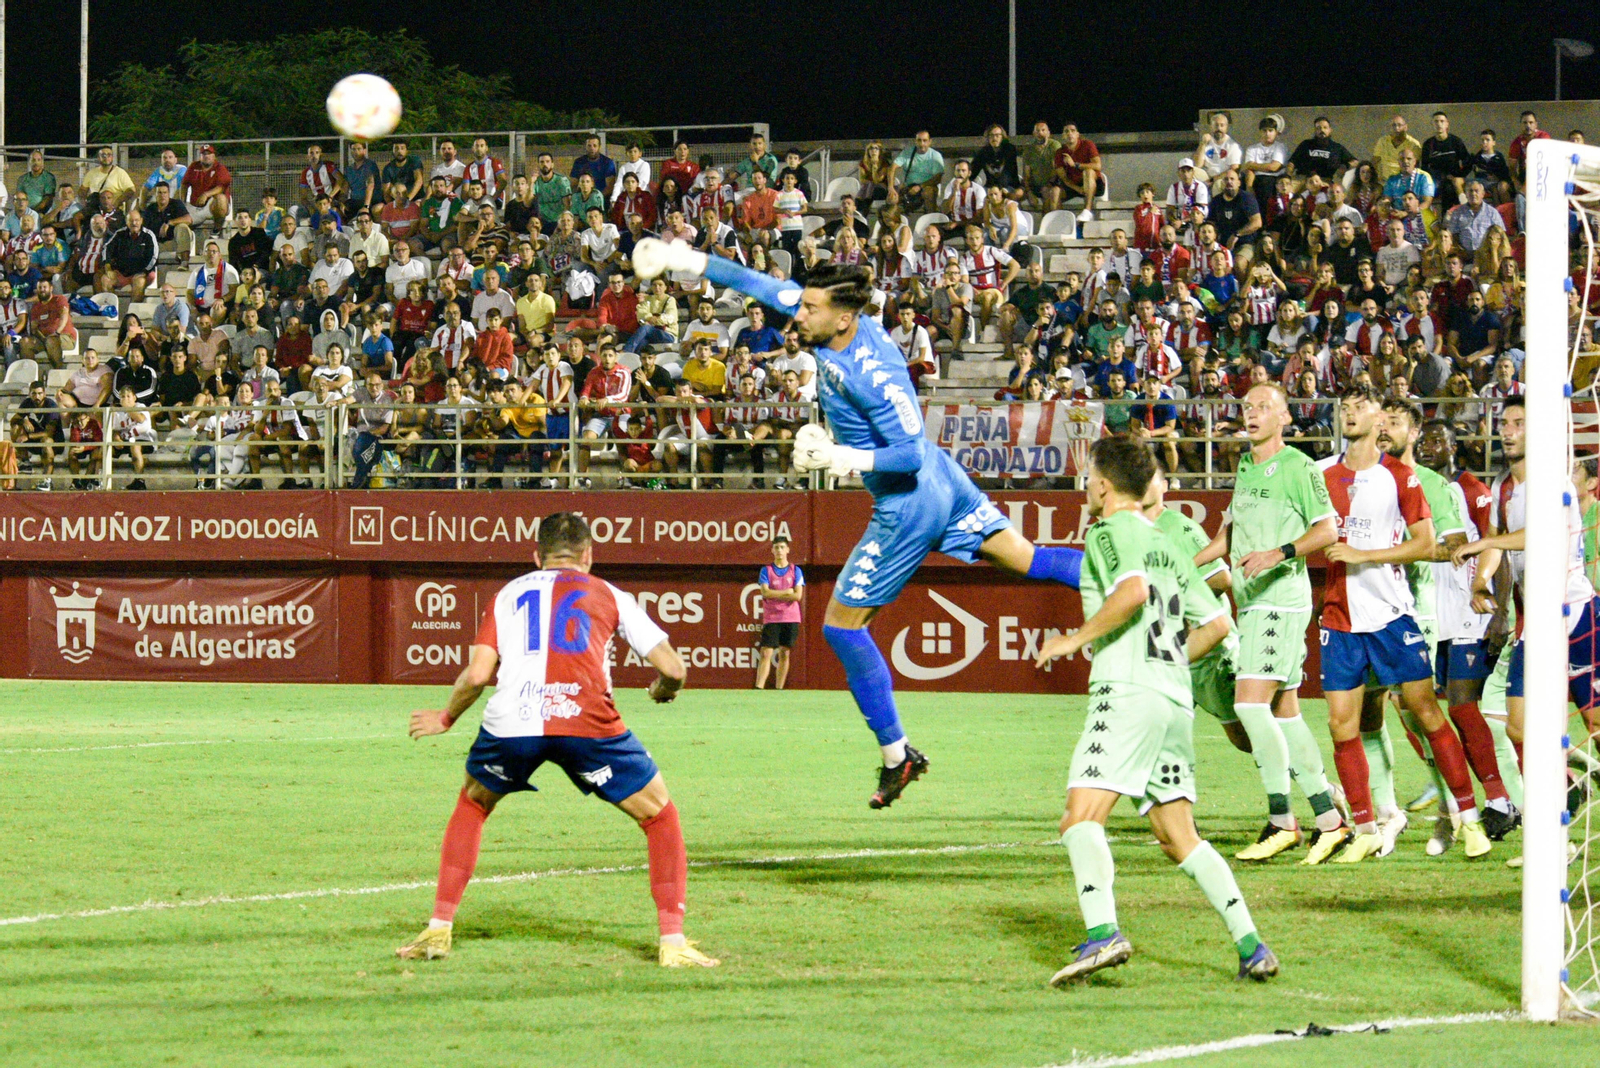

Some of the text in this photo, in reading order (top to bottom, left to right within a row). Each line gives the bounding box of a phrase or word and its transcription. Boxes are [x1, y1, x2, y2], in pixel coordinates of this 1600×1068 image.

[1308, 149, 1331, 159] VANS
[942, 411, 1009, 442] PEÑA
[190, 513, 319, 539] PODOLOGÍA
[390, 511, 510, 542] CLÍNICA
[515, 511, 633, 543] MOZ
[654, 516, 793, 542] PODOLOGÍA
[117, 598, 315, 631] Ayuntamiento
[411, 621, 461, 630] ALGECIRAS
[512, 589, 591, 656] 16
[134, 631, 297, 666] de Algeciras
[406, 644, 462, 665] CON
